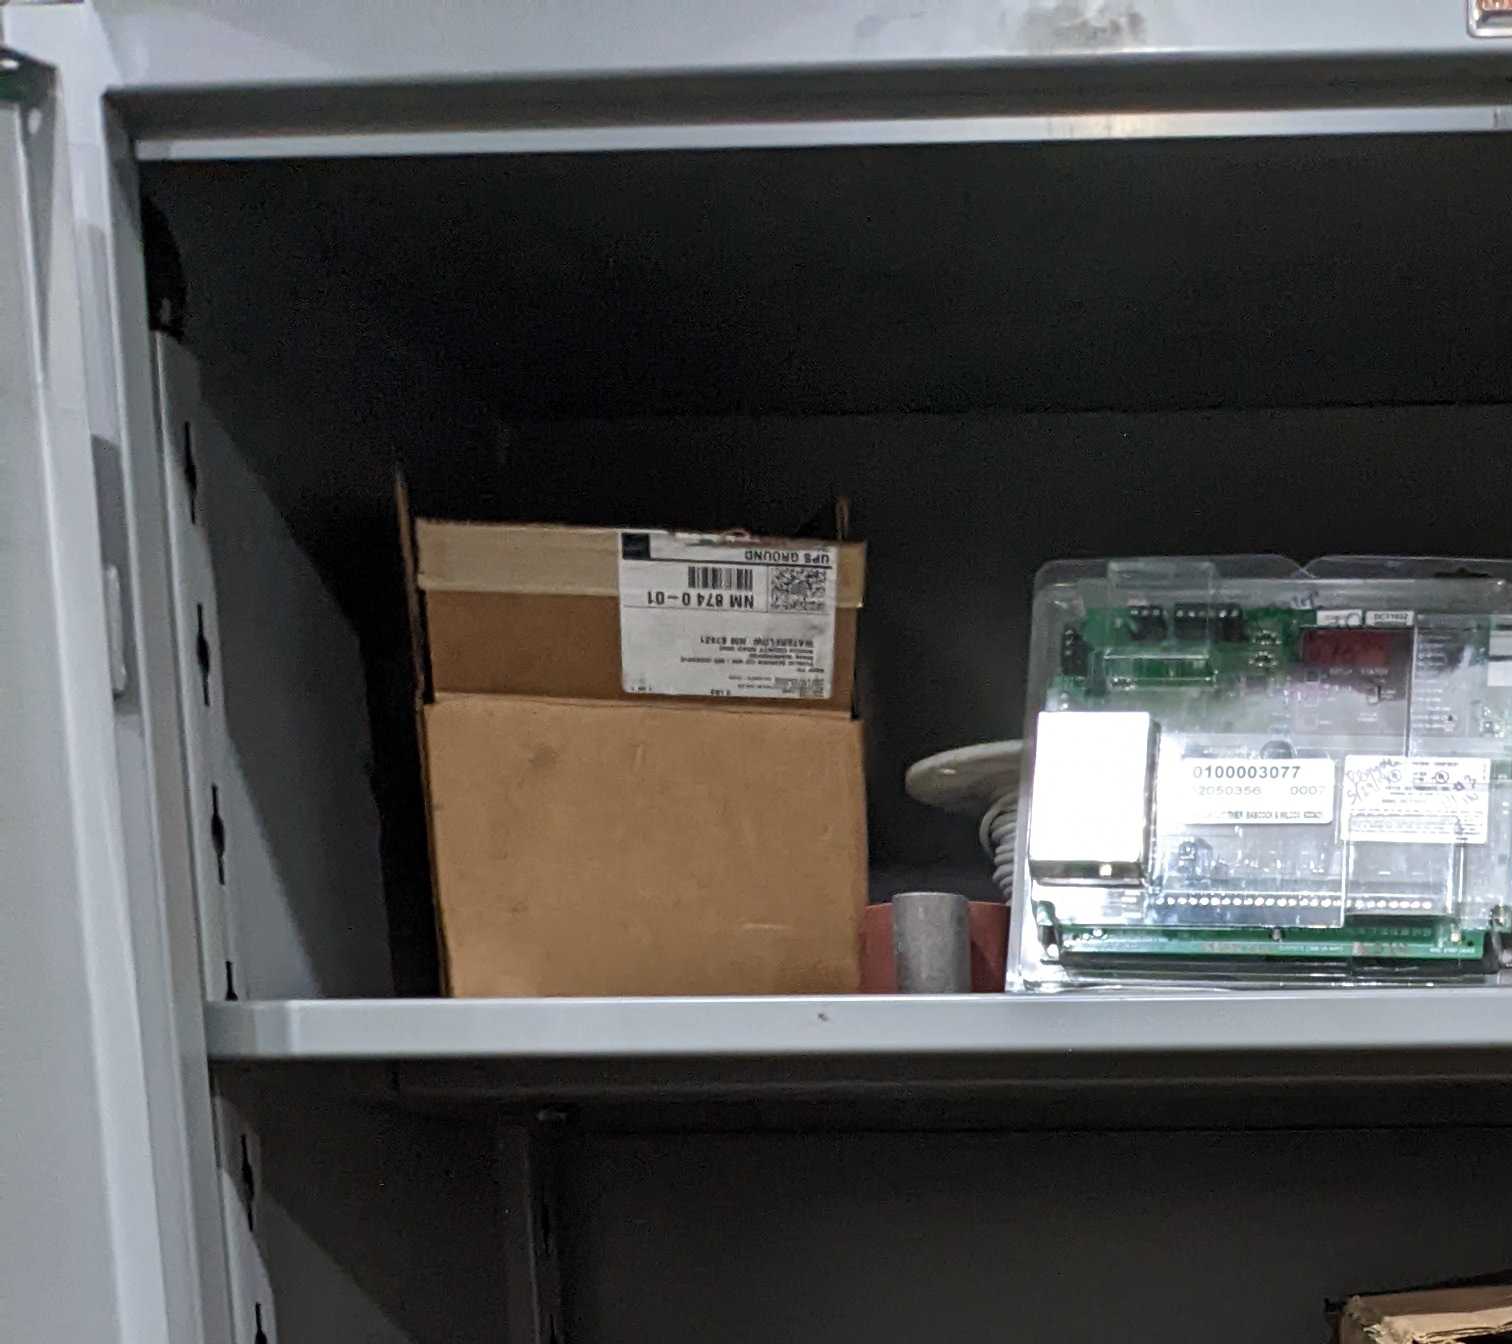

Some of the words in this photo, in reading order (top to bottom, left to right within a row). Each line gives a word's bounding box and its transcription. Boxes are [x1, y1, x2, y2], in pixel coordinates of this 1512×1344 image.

[745, 551, 798, 562] GROUND
[804, 552, 829, 563] UPS
[697, 594, 723, 607] 874
[730, 595, 754, 608] NM
[1193, 766, 1300, 778] 0100003077
[1193, 786, 1262, 795] 2050356
